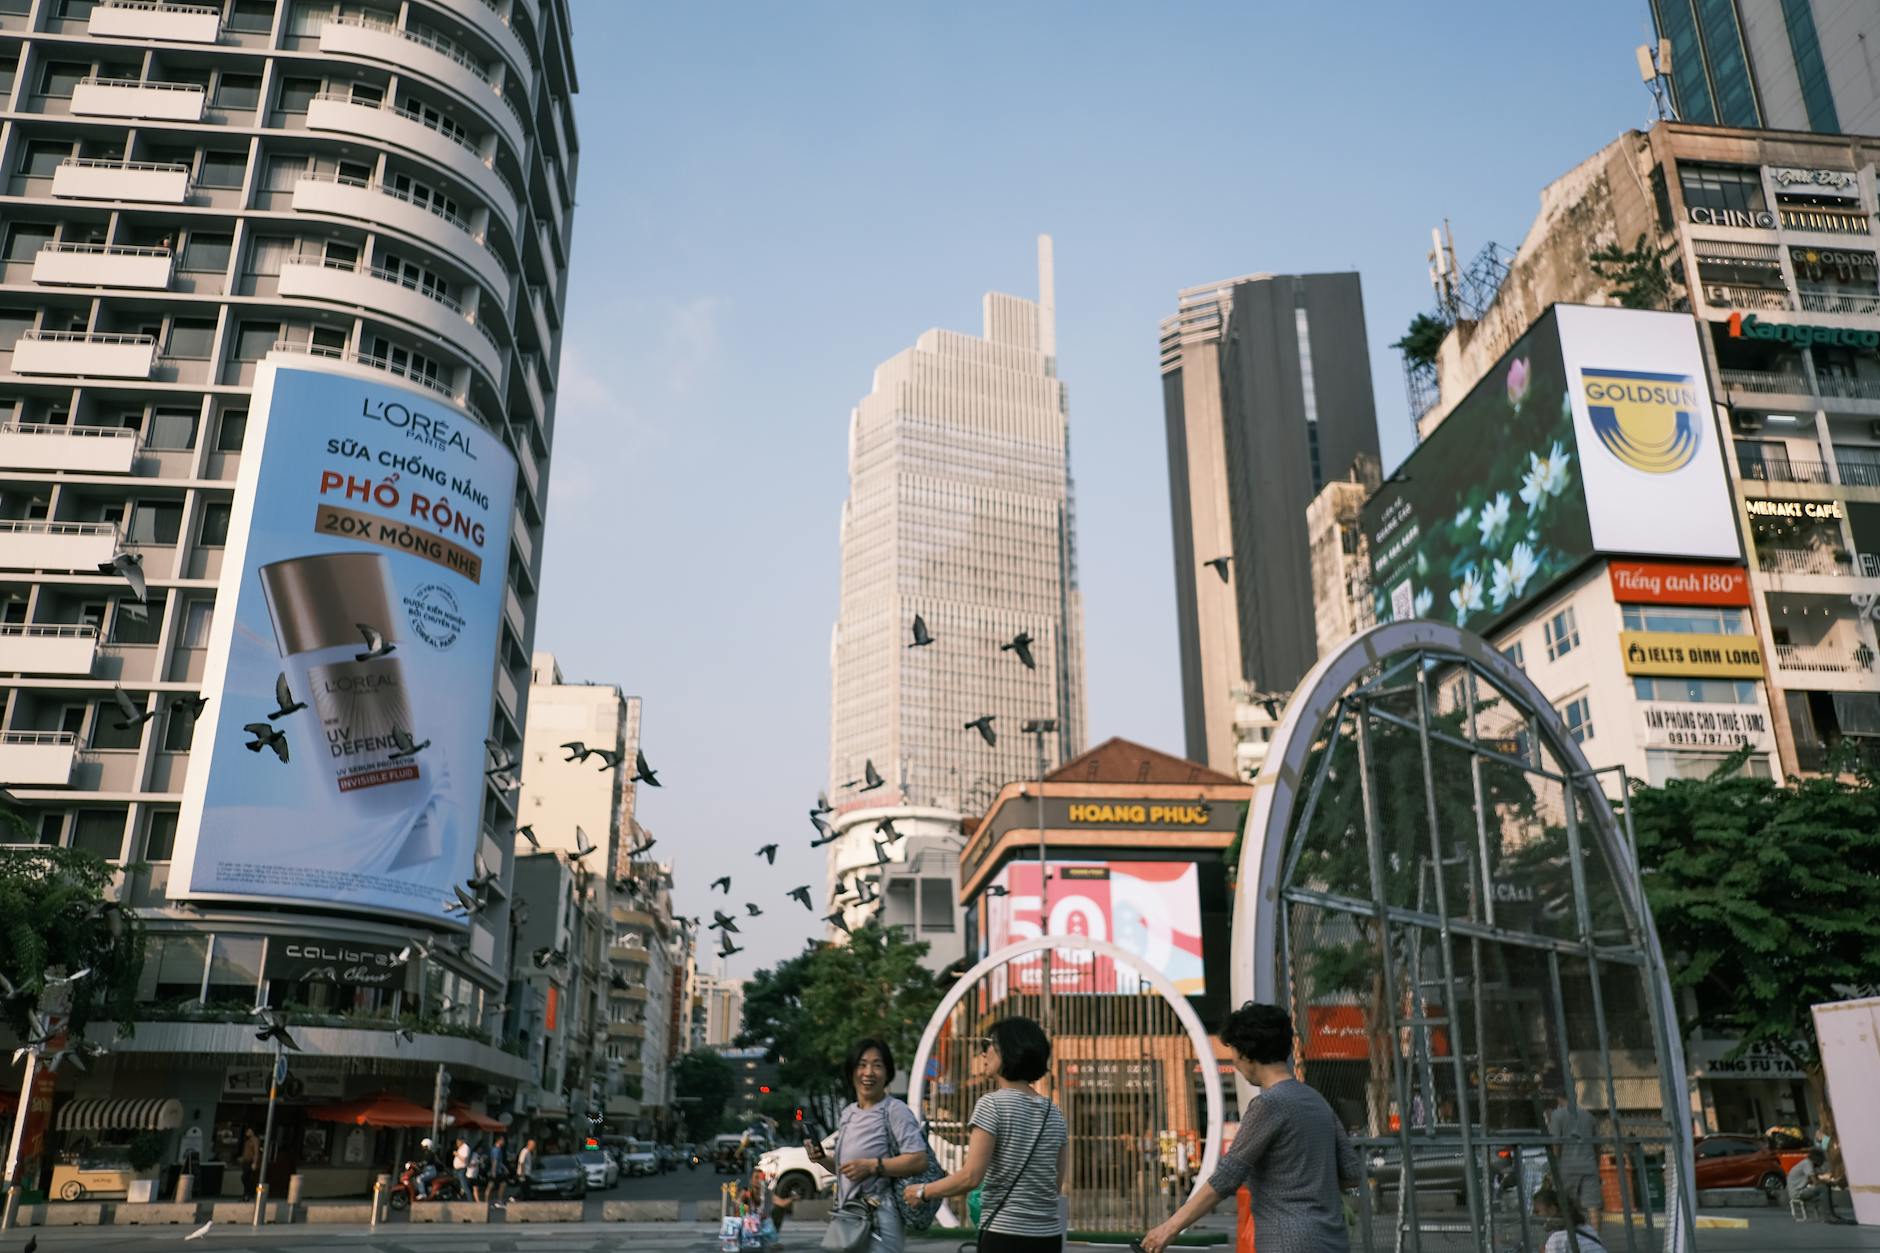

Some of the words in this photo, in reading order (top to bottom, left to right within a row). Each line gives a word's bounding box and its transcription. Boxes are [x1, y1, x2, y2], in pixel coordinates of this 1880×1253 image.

[1741, 313, 1880, 348] Kangaroo
[1585, 383, 1697, 406] GOLDSUN
[362, 398, 477, 461] L'ORÉAL
[406, 429, 446, 452] PARIS
[326, 438, 371, 462] SỮA
[378, 450, 447, 486] CHỐNG
[451, 477, 489, 511] NẮNG
[320, 470, 400, 508] PHỔ
[410, 491, 485, 548] RỘNG
[1745, 500, 1803, 518] MERAKI
[1804, 500, 1843, 519] CAFÉ
[324, 513, 372, 538] 20X
[379, 525, 442, 559] MỎNG
[447, 548, 478, 580] NHẸ
[1614, 568, 1661, 595] Tiếng
[1702, 574, 1733, 592] 180
[1648, 647, 1685, 663] IELTS
[1725, 650, 1761, 665] LONG
[1697, 709, 1717, 734] CHO
[327, 727, 350, 744] UV
[340, 773, 386, 790] INVISIBLE
[390, 768, 414, 780] FLUID
[1068, 803, 1146, 823] HOANG
[1707, 1059, 1746, 1073] XING
[1750, 1059, 1771, 1072] FU
